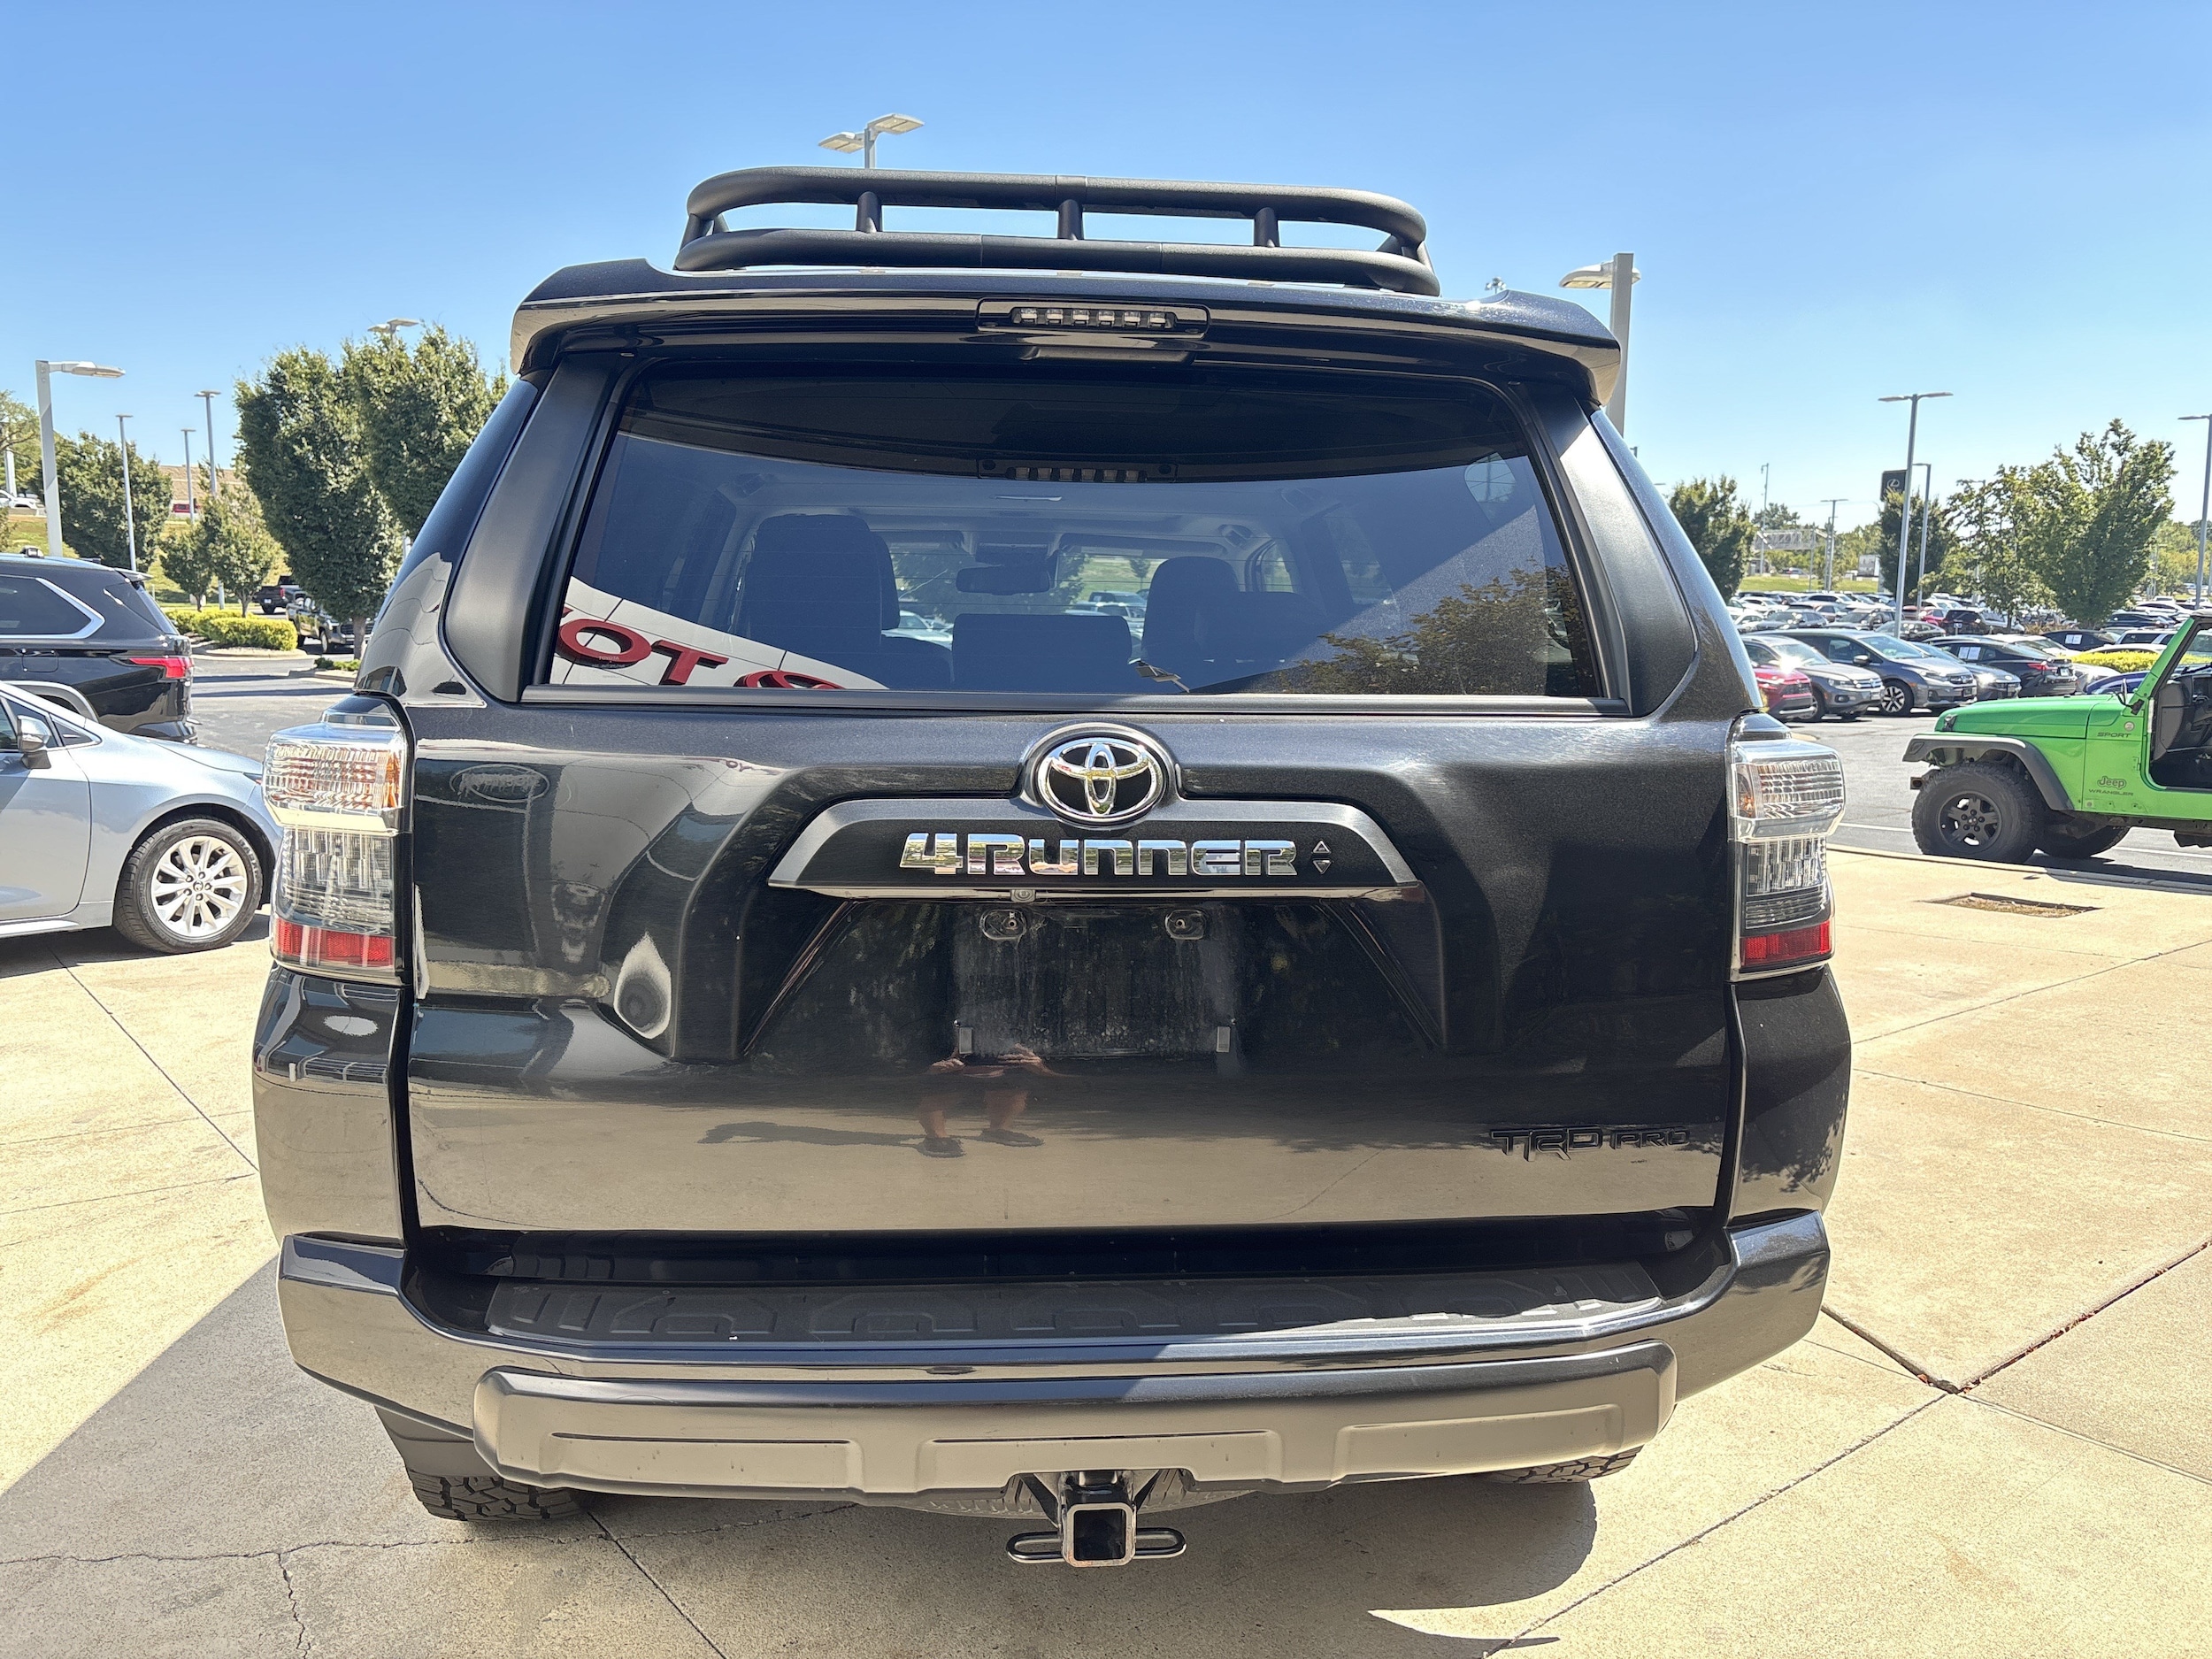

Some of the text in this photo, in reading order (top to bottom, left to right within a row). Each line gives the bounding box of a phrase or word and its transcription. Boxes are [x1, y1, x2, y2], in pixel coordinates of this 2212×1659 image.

[2098, 777, 2126, 788] Jeep
[1489, 1125, 1692, 1163] TRD PRO
